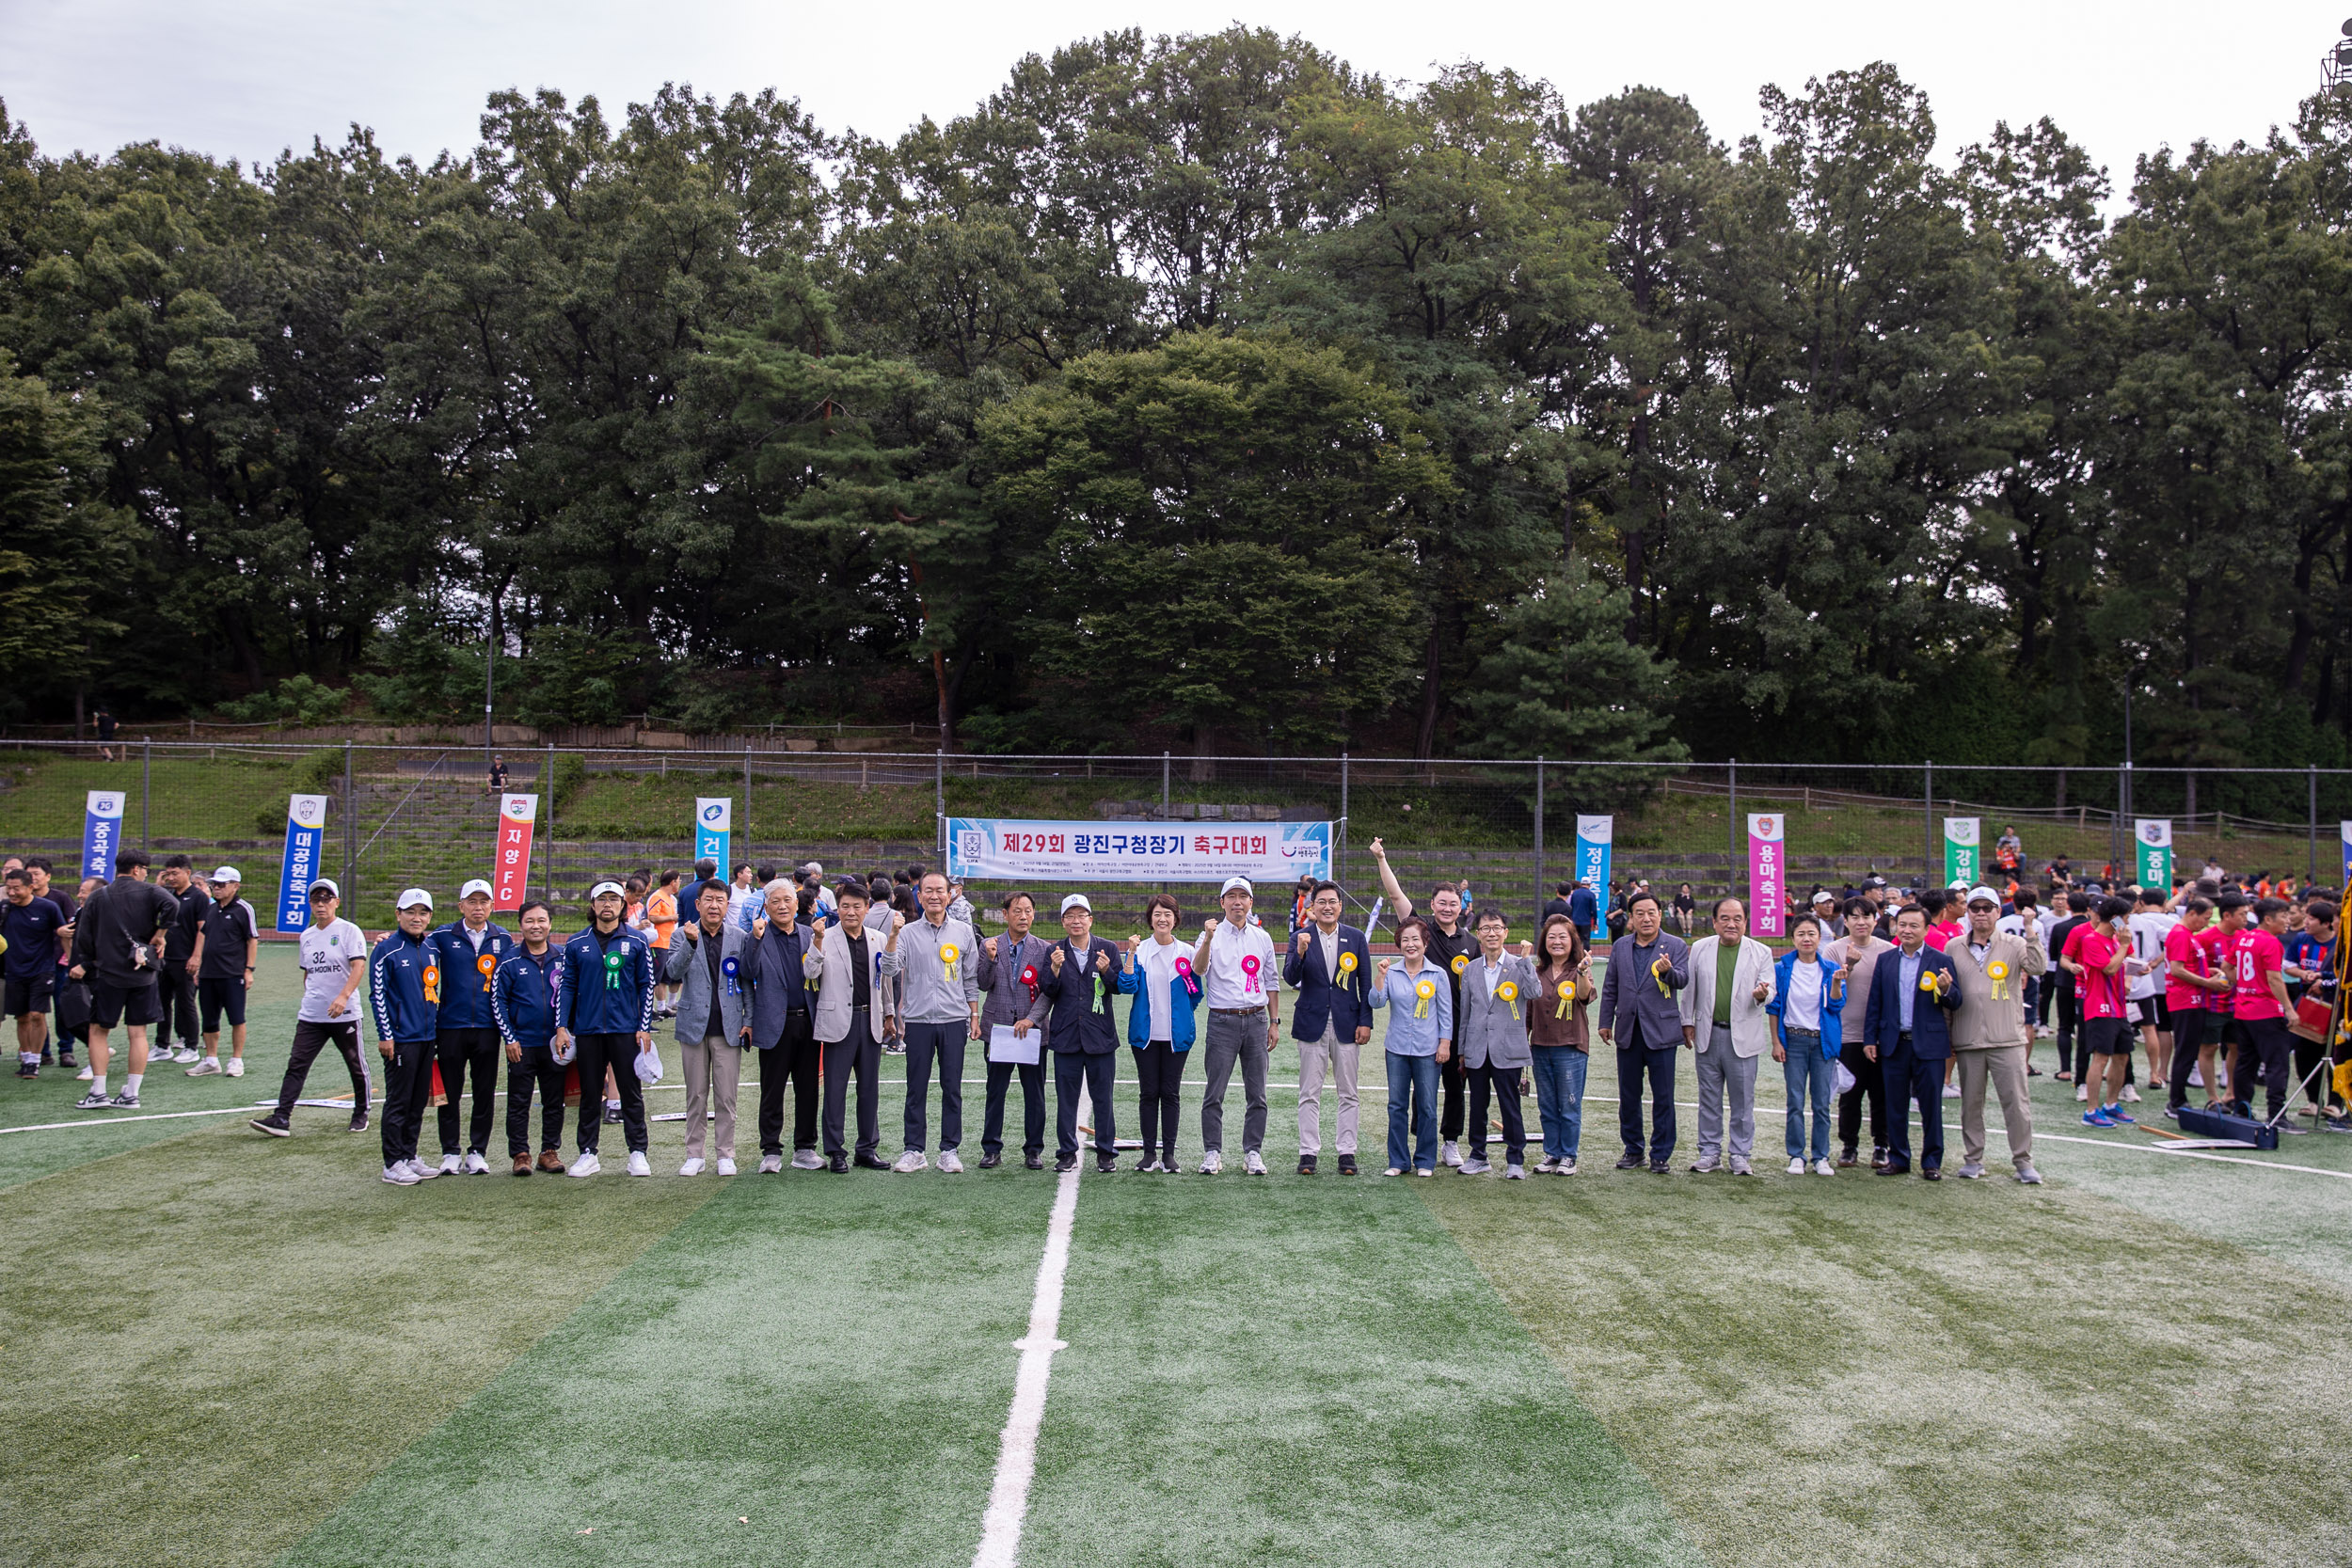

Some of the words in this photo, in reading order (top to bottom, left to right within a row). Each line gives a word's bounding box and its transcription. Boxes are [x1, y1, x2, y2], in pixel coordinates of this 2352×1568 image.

[89, 822, 111, 879] 중곡축
[1003, 833, 1065, 853] 제29회
[1073, 834, 1185, 855] 광진구청장기
[1194, 835, 1267, 855] 축구대회
[285, 832, 312, 926] 대공원축구회
[1586, 847, 1603, 934] 정립축
[1758, 845, 1777, 932] 용마축구회
[312, 951, 326, 964] 32
[314, 965, 332, 974] MOON
[332, 964, 342, 973] FC
[2235, 950, 2255, 982] 18
